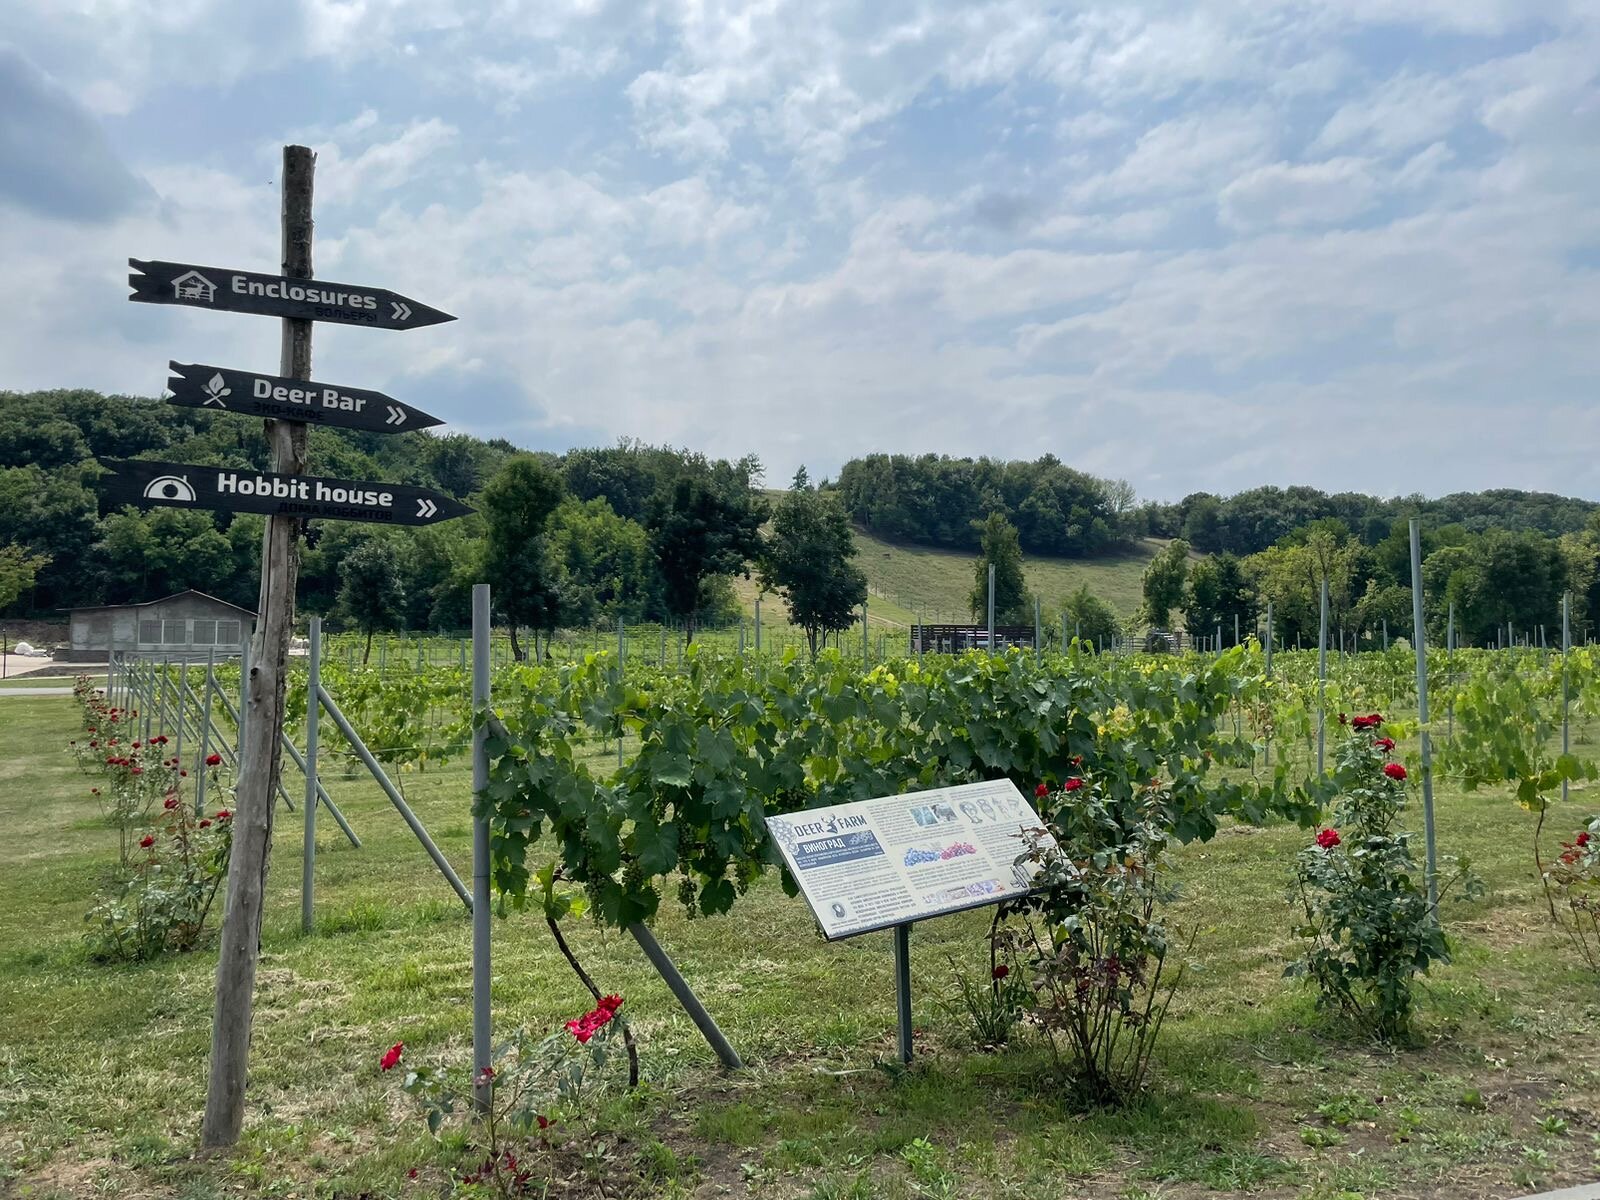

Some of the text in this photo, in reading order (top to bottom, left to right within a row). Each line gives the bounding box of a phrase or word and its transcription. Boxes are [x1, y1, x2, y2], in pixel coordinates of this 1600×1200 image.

[231, 275, 377, 309] Enclosures
[315, 307, 377, 322] ВОЛЬЕРЫ
[253, 378, 367, 412] Deer Bar
[217, 472, 393, 507] Hobbit house
[279, 502, 321, 514] ДОМА
[794, 815, 867, 837] DEER FARM
[803, 838, 846, 854] ВИНОГРАД
